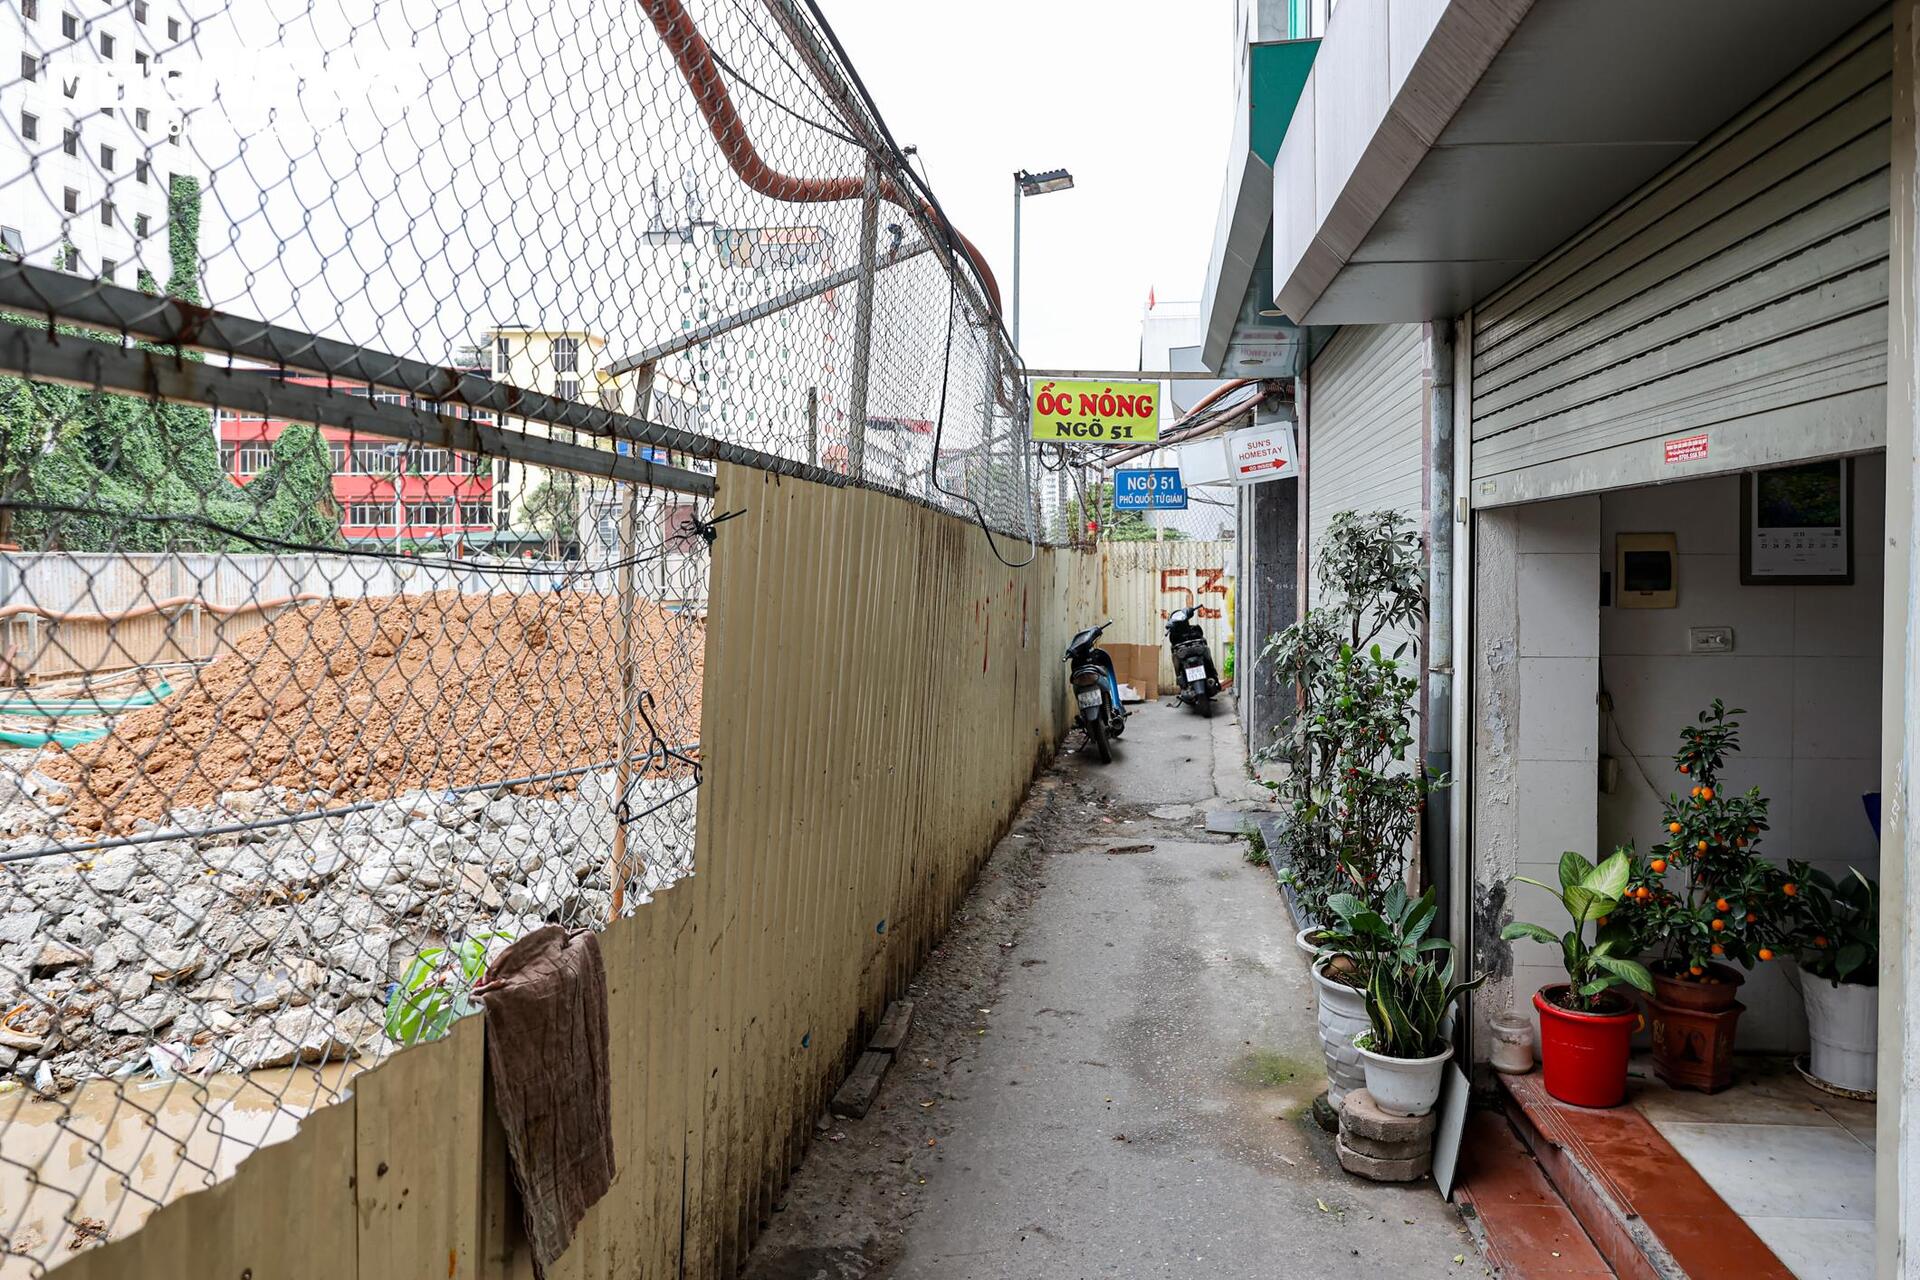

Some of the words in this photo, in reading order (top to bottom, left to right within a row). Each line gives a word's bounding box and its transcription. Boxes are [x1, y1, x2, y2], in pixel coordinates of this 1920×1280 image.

[1036, 382, 1072, 416] ỐC
[1078, 387, 1154, 418] NÓNG
[1055, 418, 1104, 437] NGÕ
[1110, 425, 1134, 439] 51
[1247, 439, 1271, 450] SUN'S
[1238, 446, 1283, 461] HOMESTAY
[1127, 473, 1157, 490] NGÕ
[1160, 476, 1175, 490] 51
[1119, 492, 1134, 504] PHỐ
[1165, 492, 1183, 504] GIÁM
